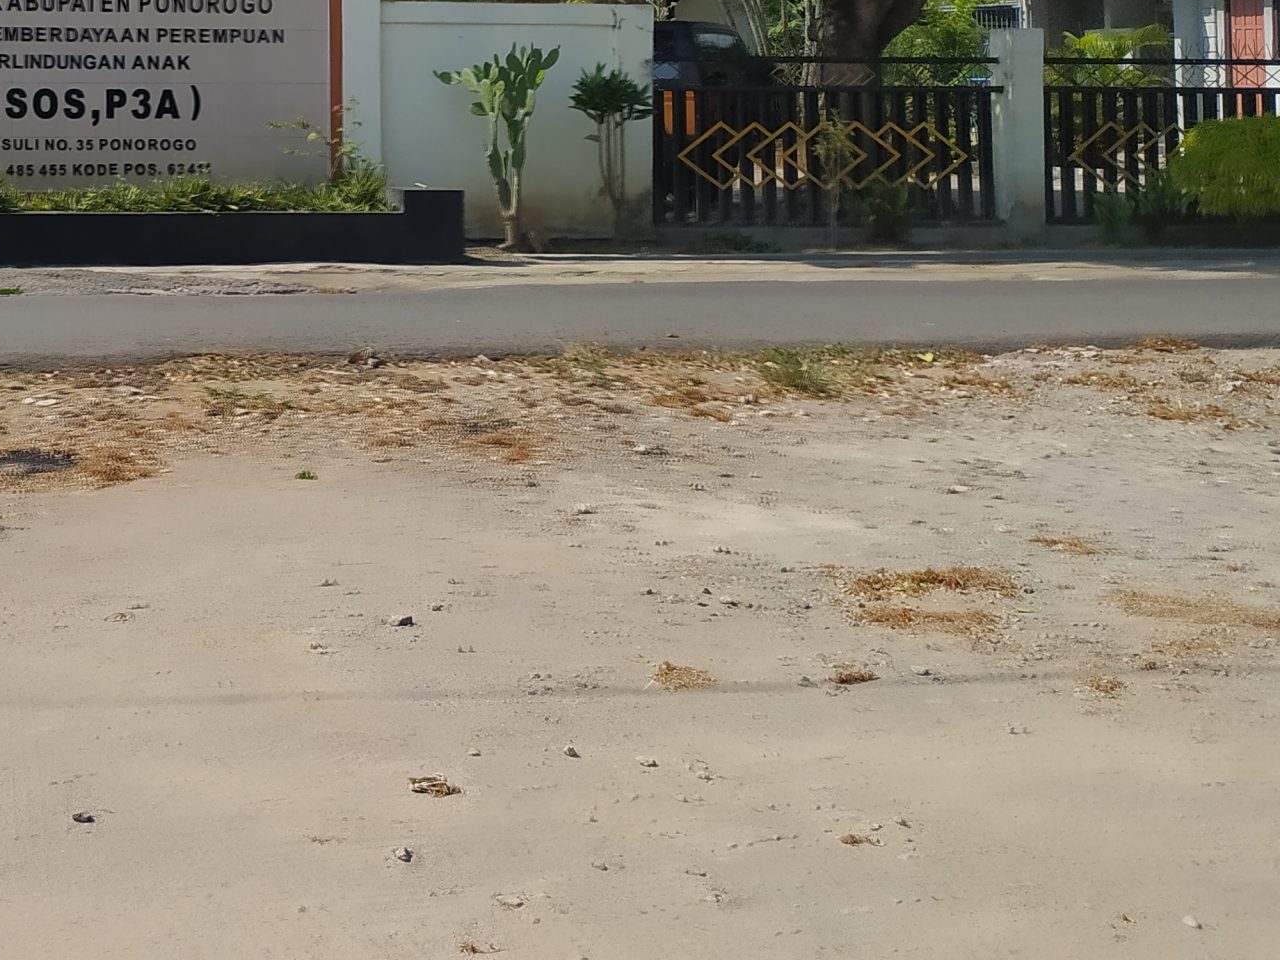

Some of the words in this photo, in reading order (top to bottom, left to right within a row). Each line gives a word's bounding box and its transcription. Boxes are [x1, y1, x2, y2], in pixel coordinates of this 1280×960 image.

[156, 27, 285, 44] PEREMPUAN
[131, 54, 191, 71] ANAK
[44, 139, 72, 151] NO.
[76, 139, 94, 151] 35
[99, 139, 196, 151] PONOROGO
[6, 164, 35, 177] 485
[39, 164, 67, 177] 455
[72, 163, 119, 176] KODE
[123, 163, 162, 176] POS.
